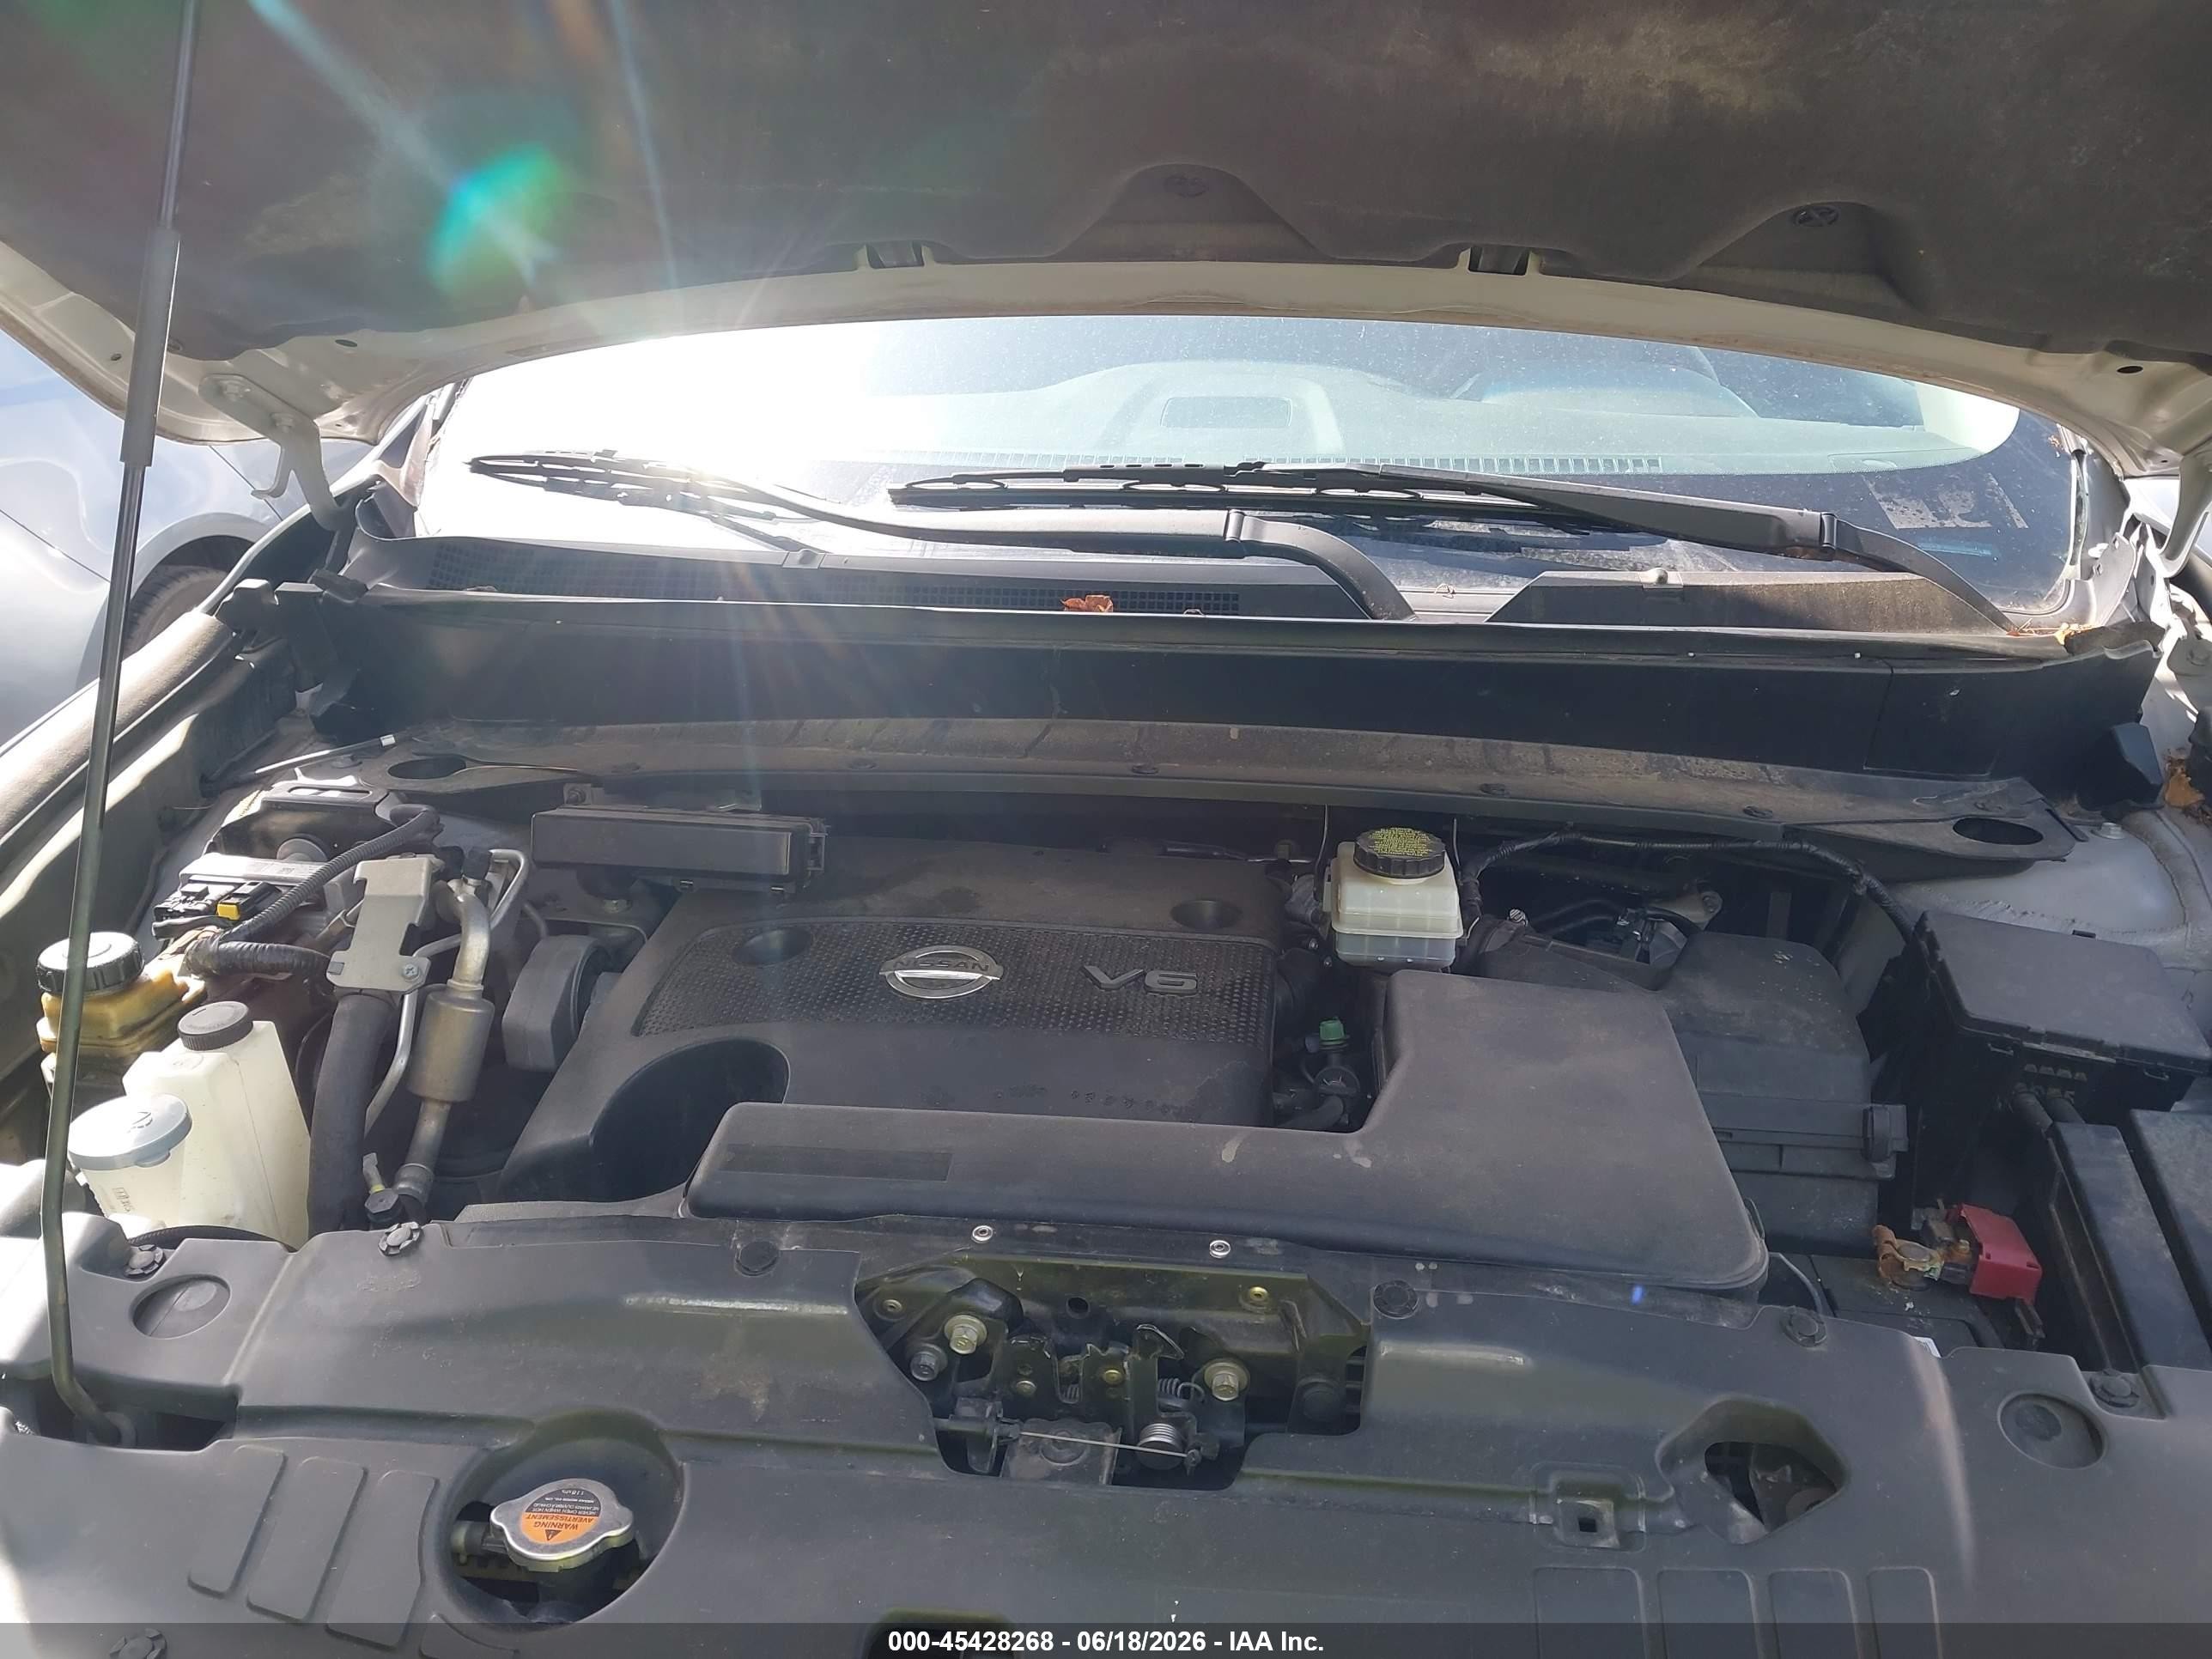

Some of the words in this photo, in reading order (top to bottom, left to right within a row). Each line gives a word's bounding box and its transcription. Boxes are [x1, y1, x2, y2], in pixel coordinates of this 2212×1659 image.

[893, 959, 989, 972] NISSAN
[1080, 964, 1198, 994] V6
[526, 1513, 594, 1523] AVERTISSEMENT
[534, 1521, 579, 1530] WARNING
